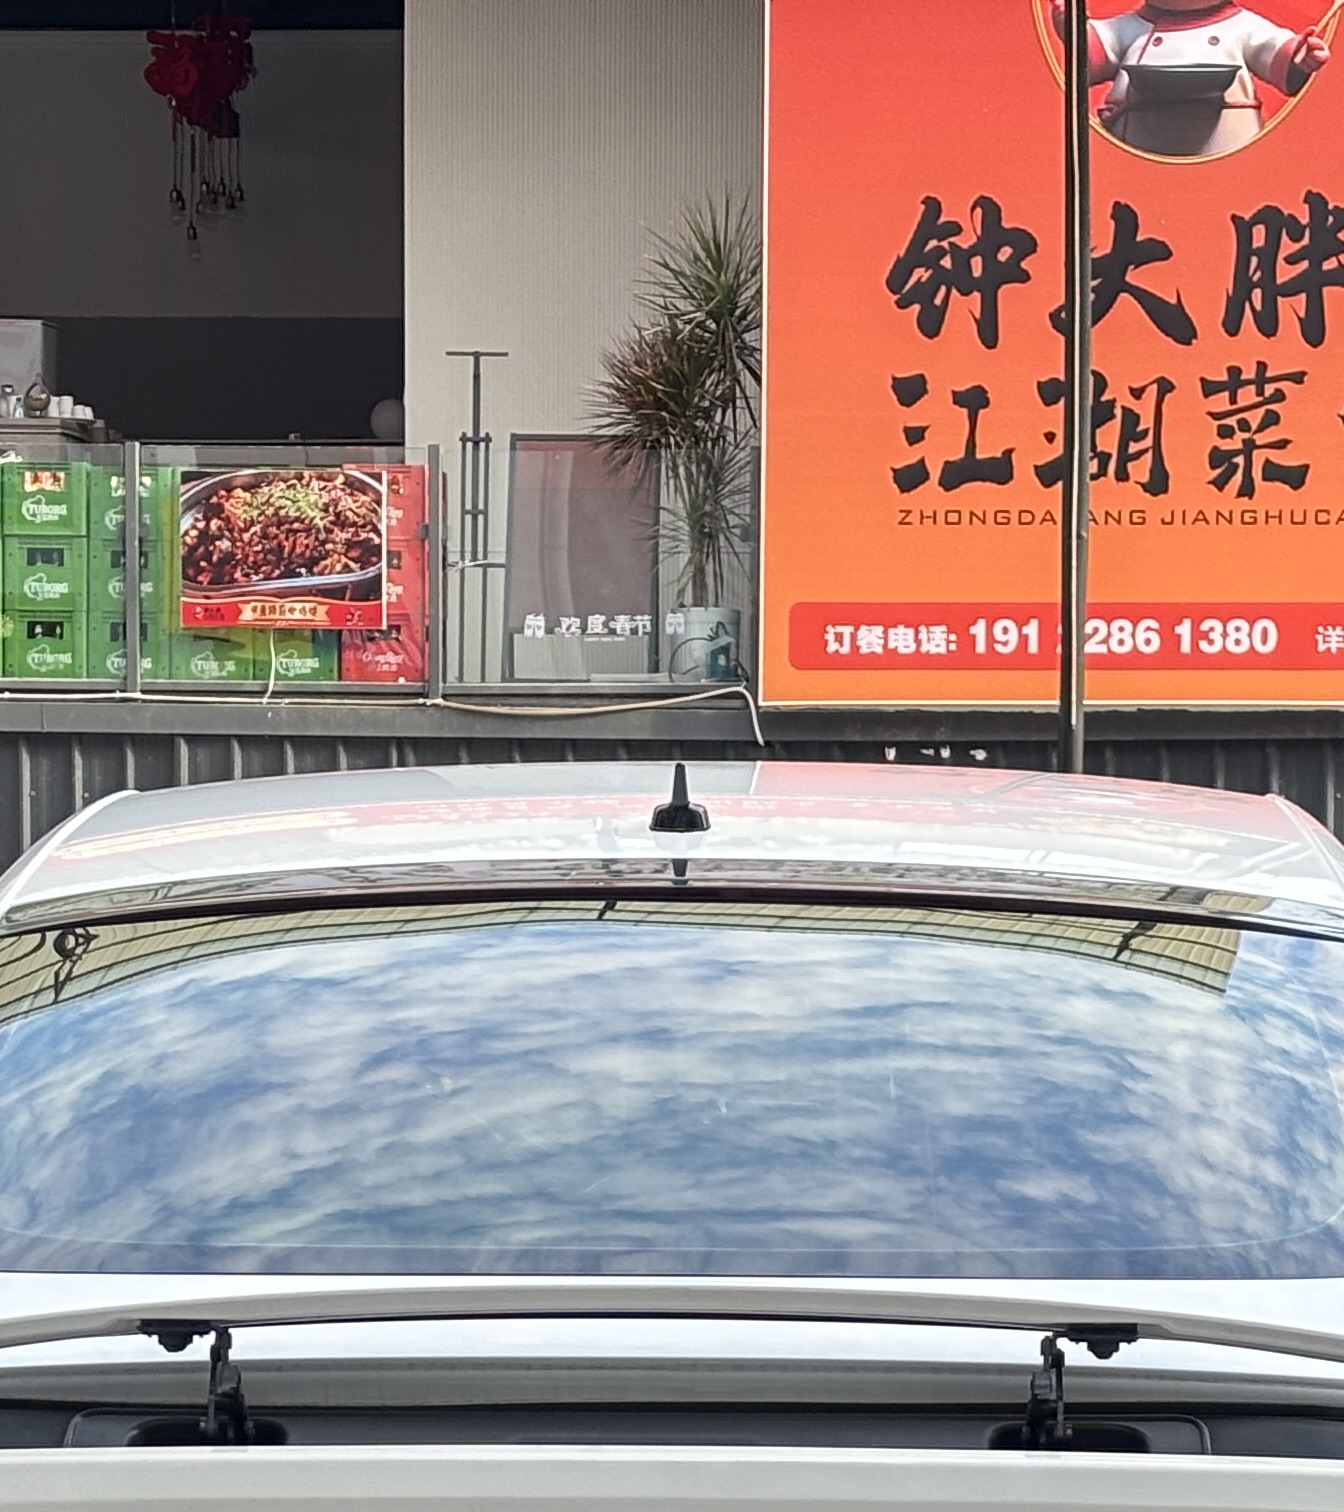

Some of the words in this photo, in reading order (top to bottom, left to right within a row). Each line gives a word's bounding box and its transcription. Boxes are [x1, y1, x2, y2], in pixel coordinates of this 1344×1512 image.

[897, 508, 1147, 526] ZHONGDAANG
[555, 614, 652, 636] 欢度春节
[824, 626, 958, 655] 订餐电话:
[969, 618, 1040, 654] 191
[1174, 618, 1279, 654] 1380
